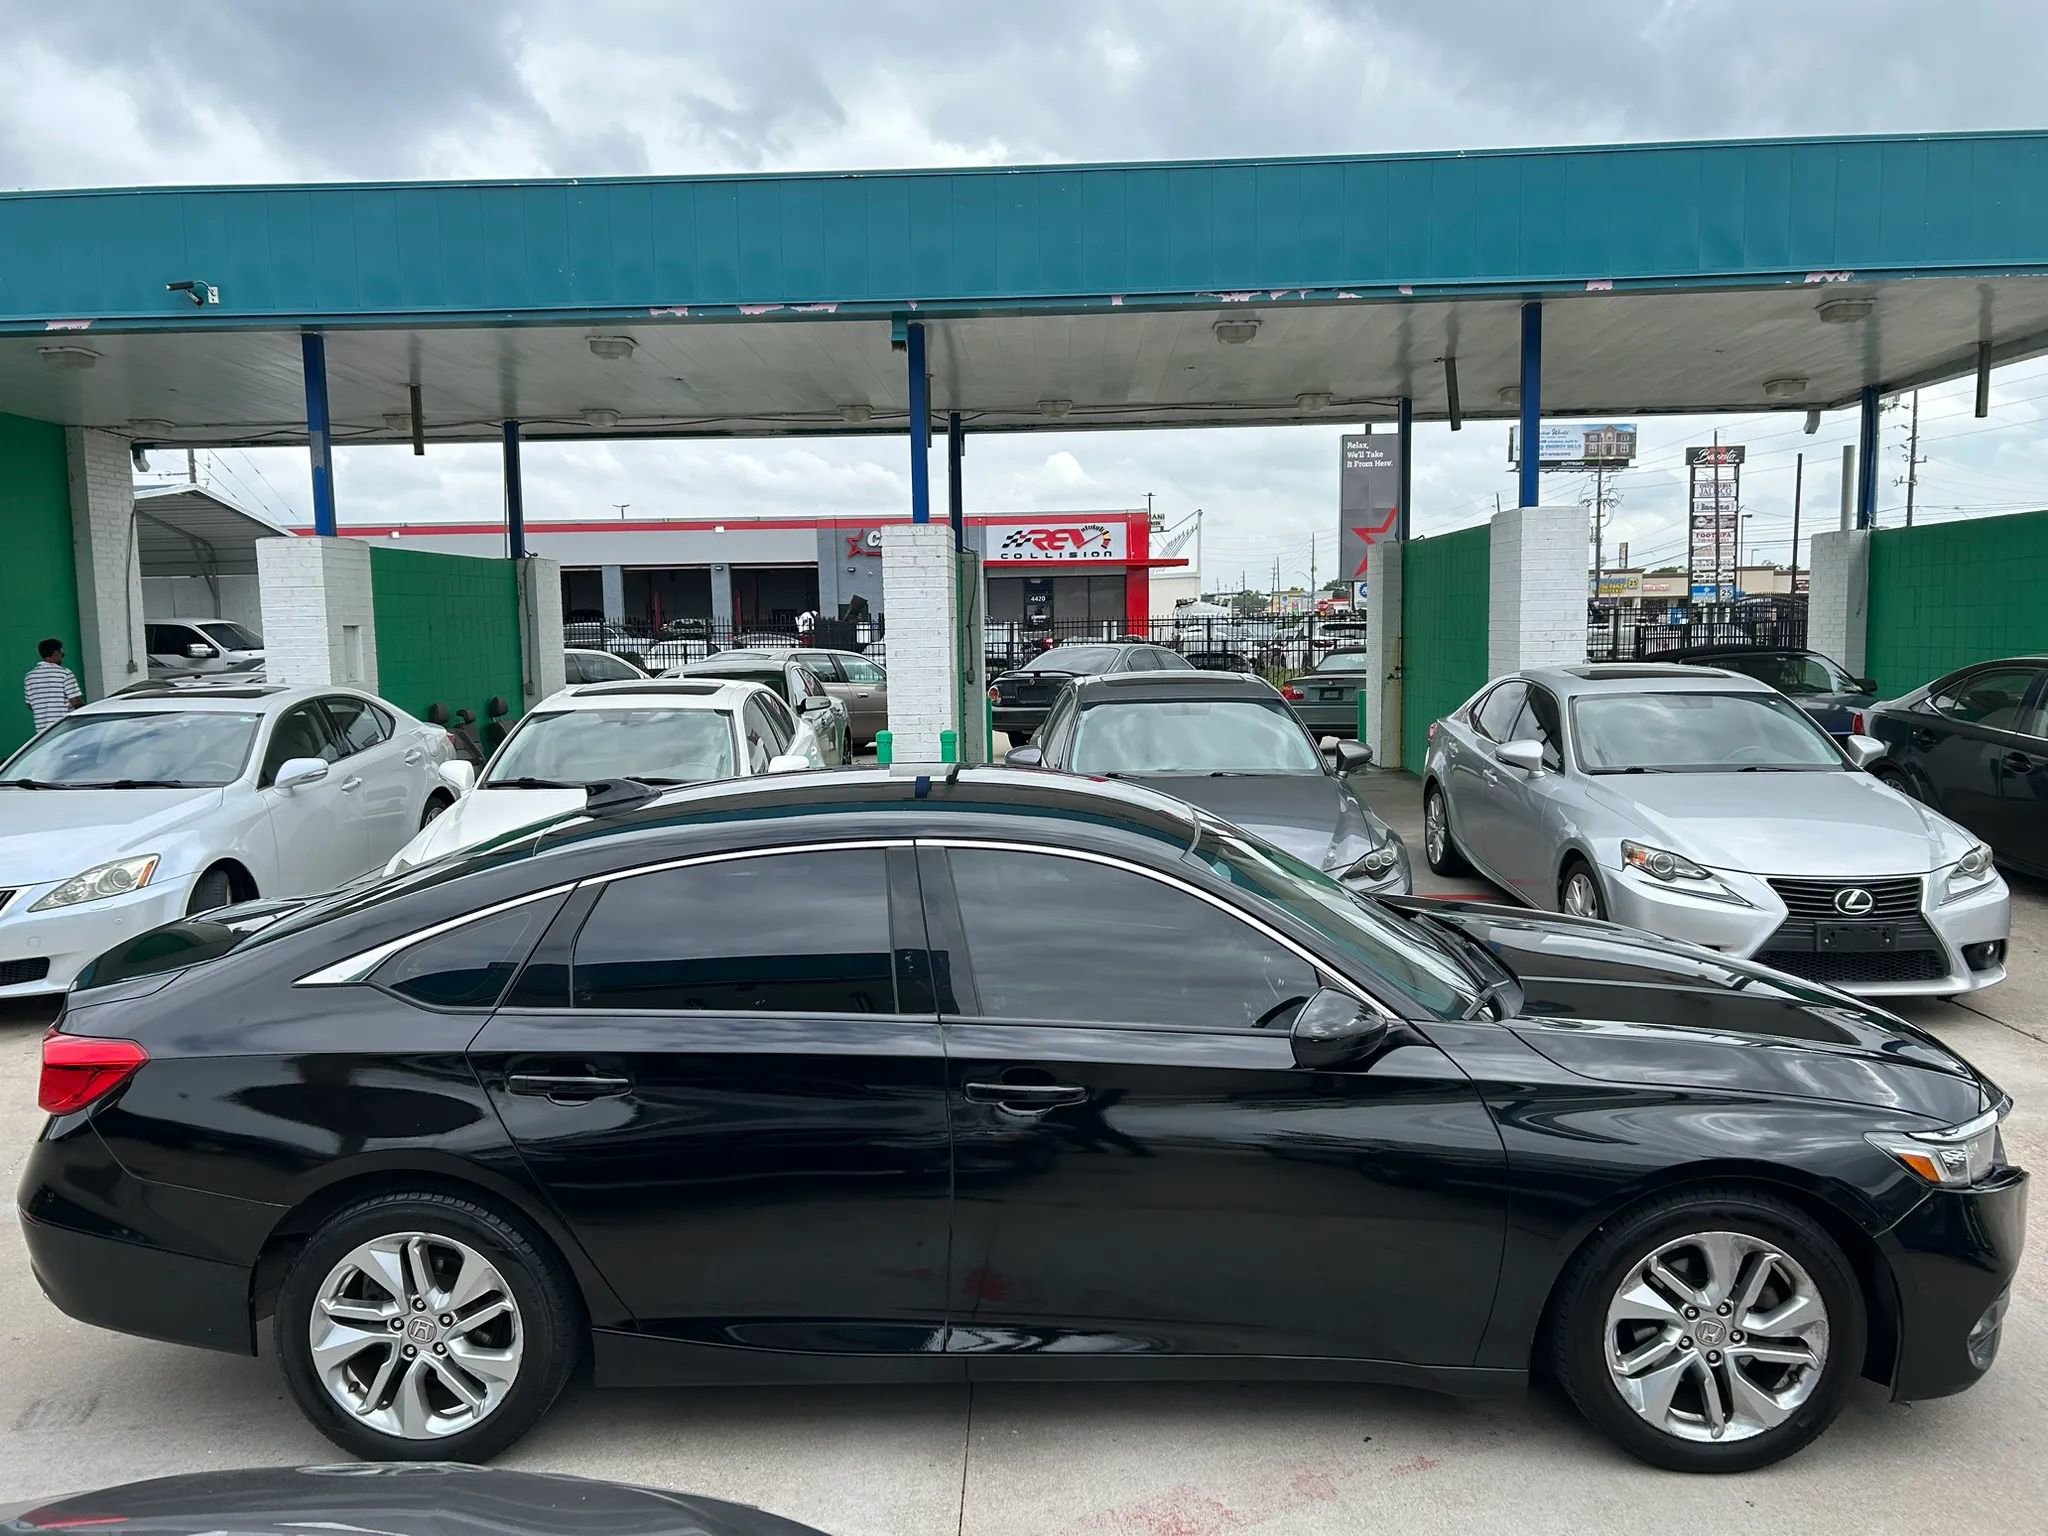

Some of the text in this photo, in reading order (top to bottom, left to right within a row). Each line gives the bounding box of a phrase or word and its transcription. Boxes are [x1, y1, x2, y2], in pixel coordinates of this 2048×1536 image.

[1347, 441, 1369, 449] Relax,
[1366, 450, 1384, 458] Take
[1023, 528, 1094, 551] REV
[1000, 551, 1112, 559] COLLISION
